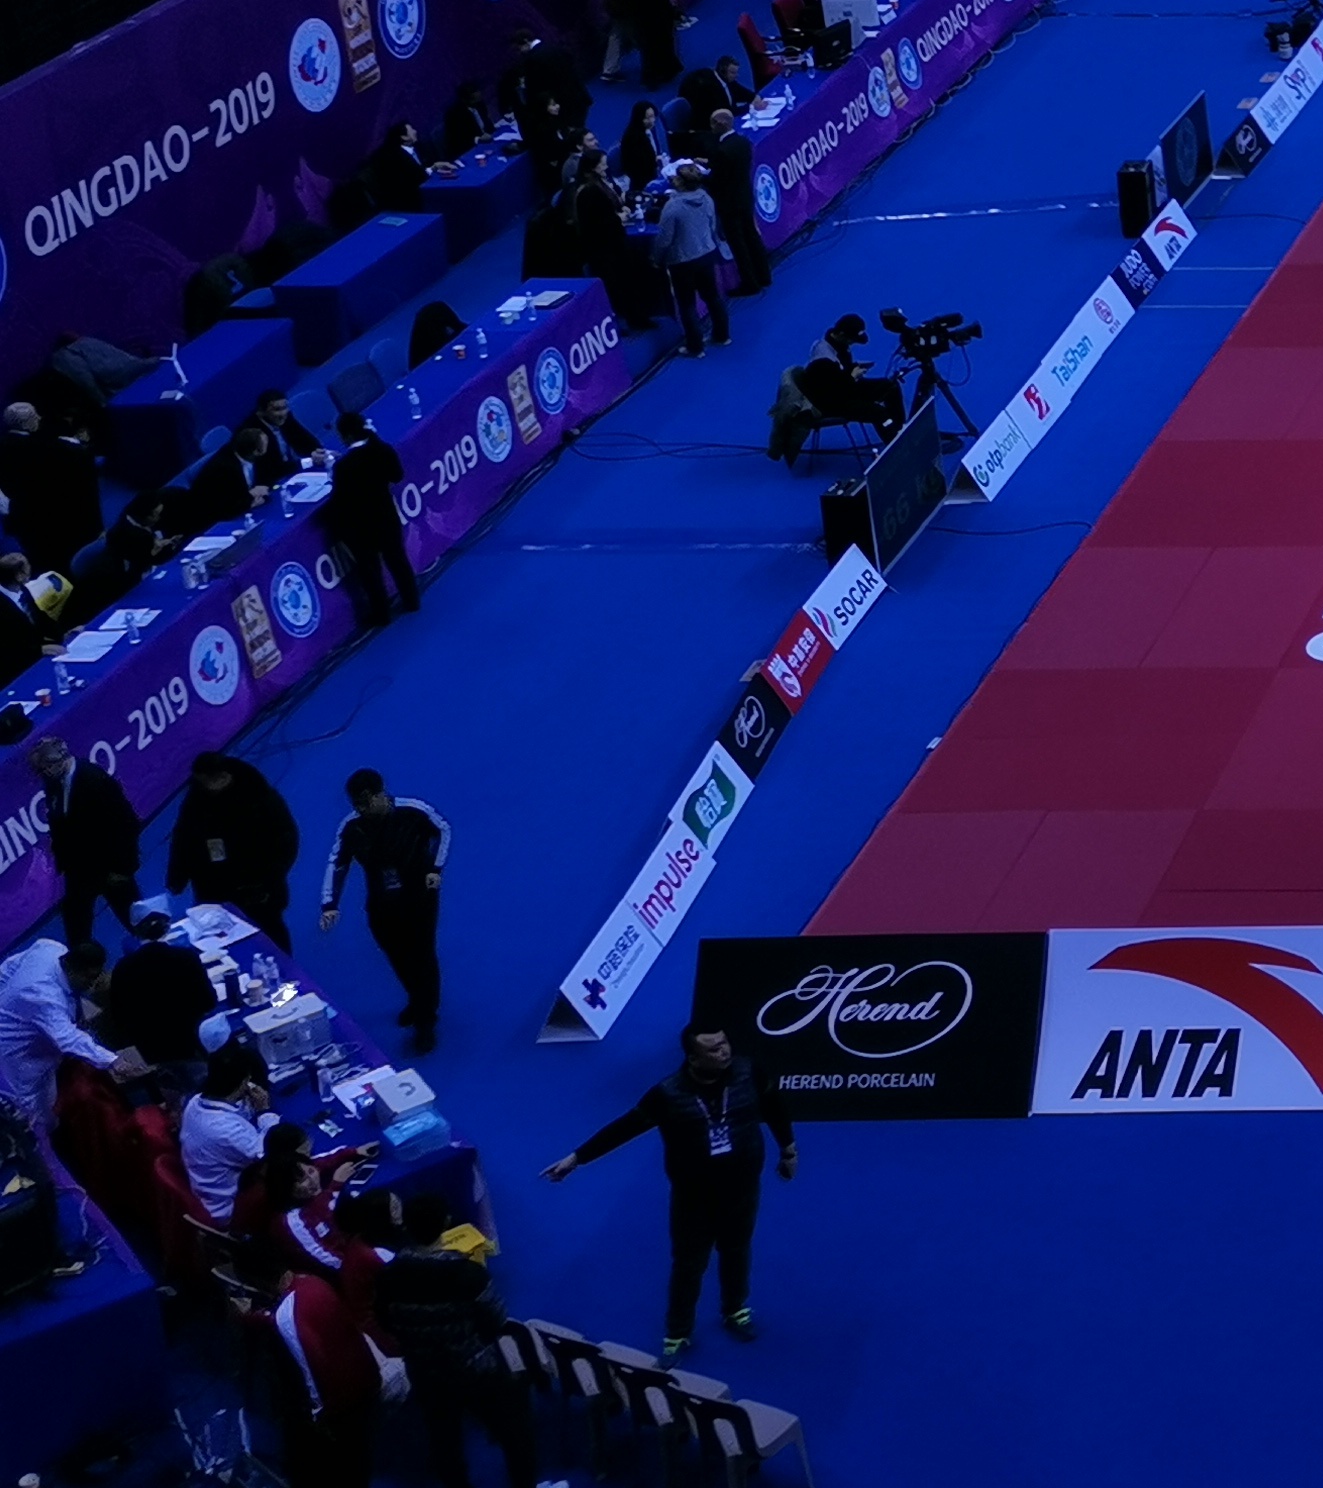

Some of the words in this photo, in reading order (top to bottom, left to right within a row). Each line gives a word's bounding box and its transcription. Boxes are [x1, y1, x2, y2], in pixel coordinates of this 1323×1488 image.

[22, 71, 276, 258] QINGDAO-2019
[777, 92, 871, 191] QINGDAO-2019
[1121, 248, 1143, 279] JUDO
[1051, 335, 1094, 387] TaiShan
[833, 568, 879, 626] SOCAR
[632, 837, 701, 929] impulse
[757, 960, 974, 1059] Herend
[778, 1073, 844, 1093] HEREND
[847, 1072, 937, 1091] PORCELAIN
[1070, 1028, 1243, 1102] ANTA
